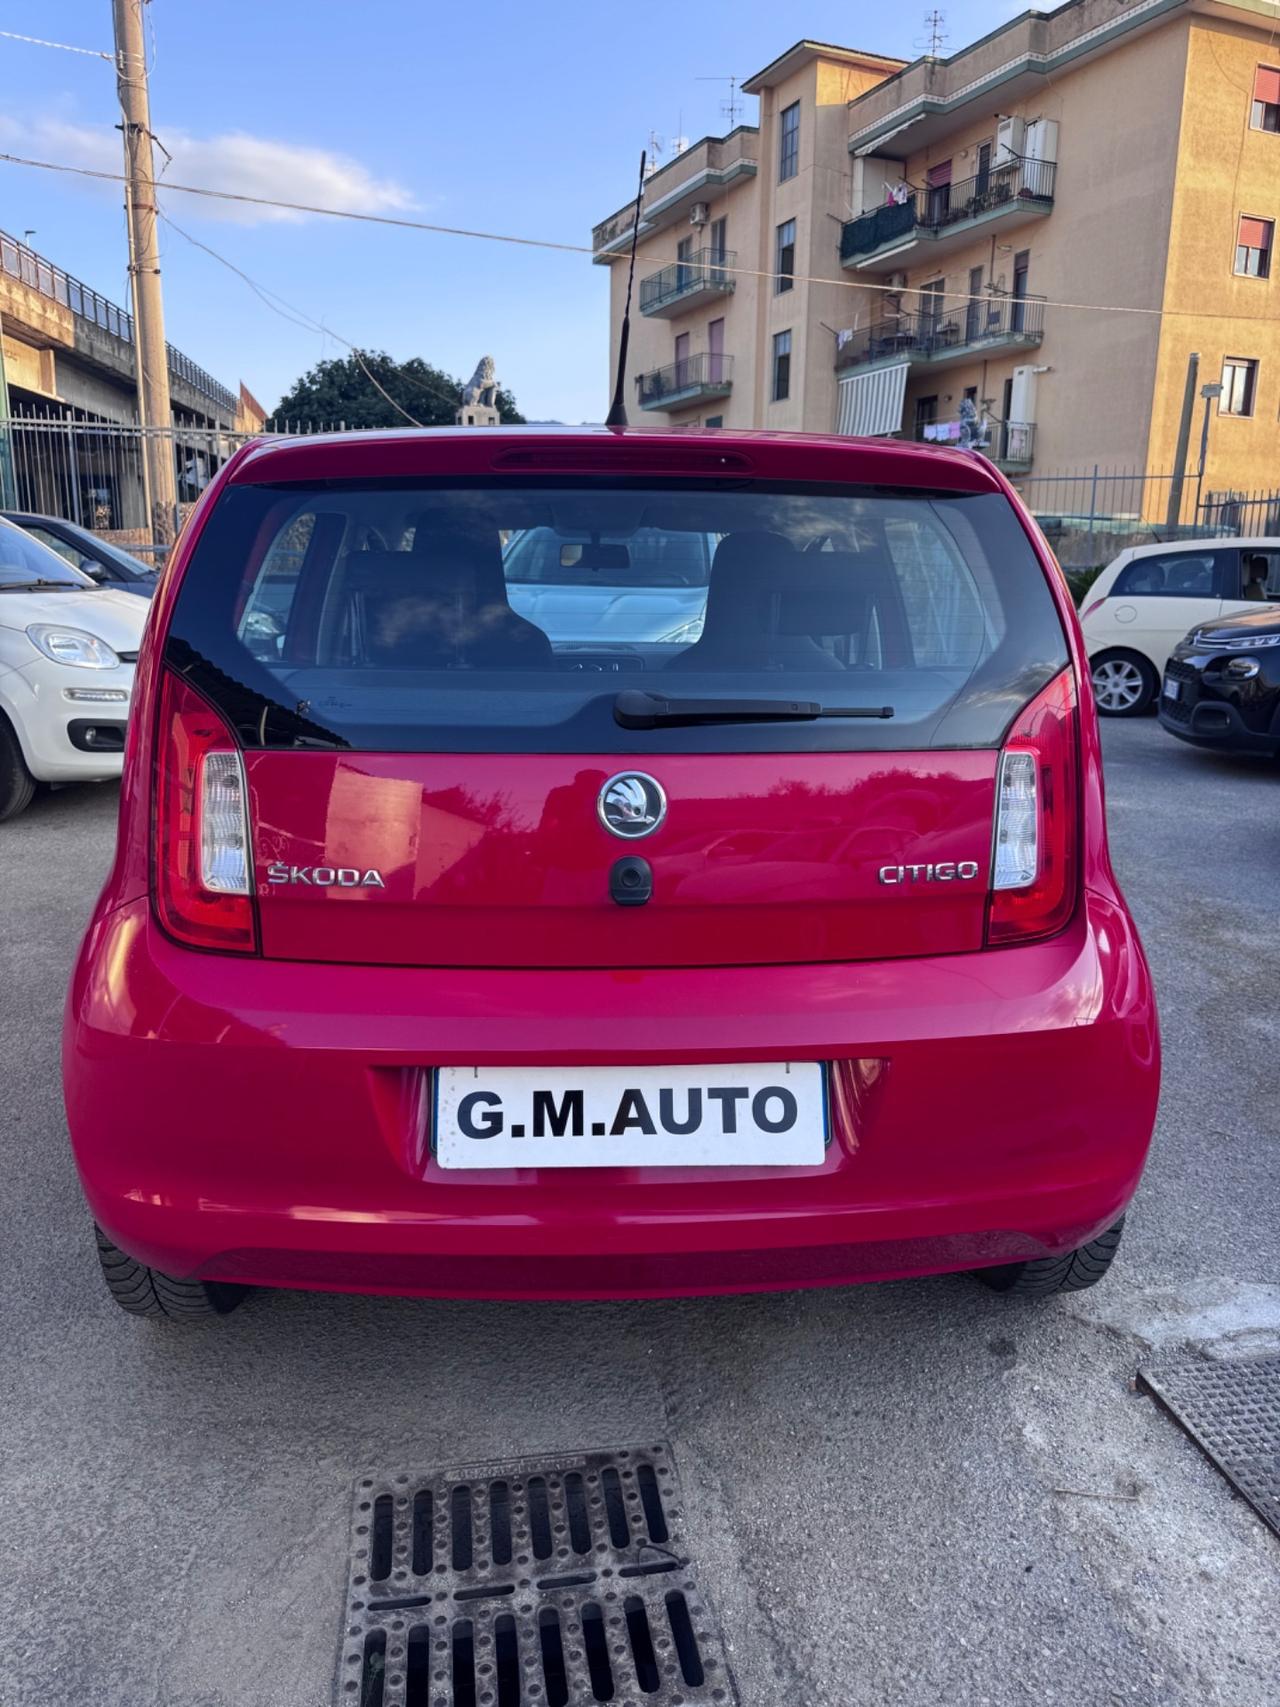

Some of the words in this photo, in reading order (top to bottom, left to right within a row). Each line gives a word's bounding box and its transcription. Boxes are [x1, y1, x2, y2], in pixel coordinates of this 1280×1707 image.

[267, 861, 385, 888] ŠKODA
[879, 861, 979, 884] CITIGO
[457, 1086, 798, 1139] G.M.AUTO
